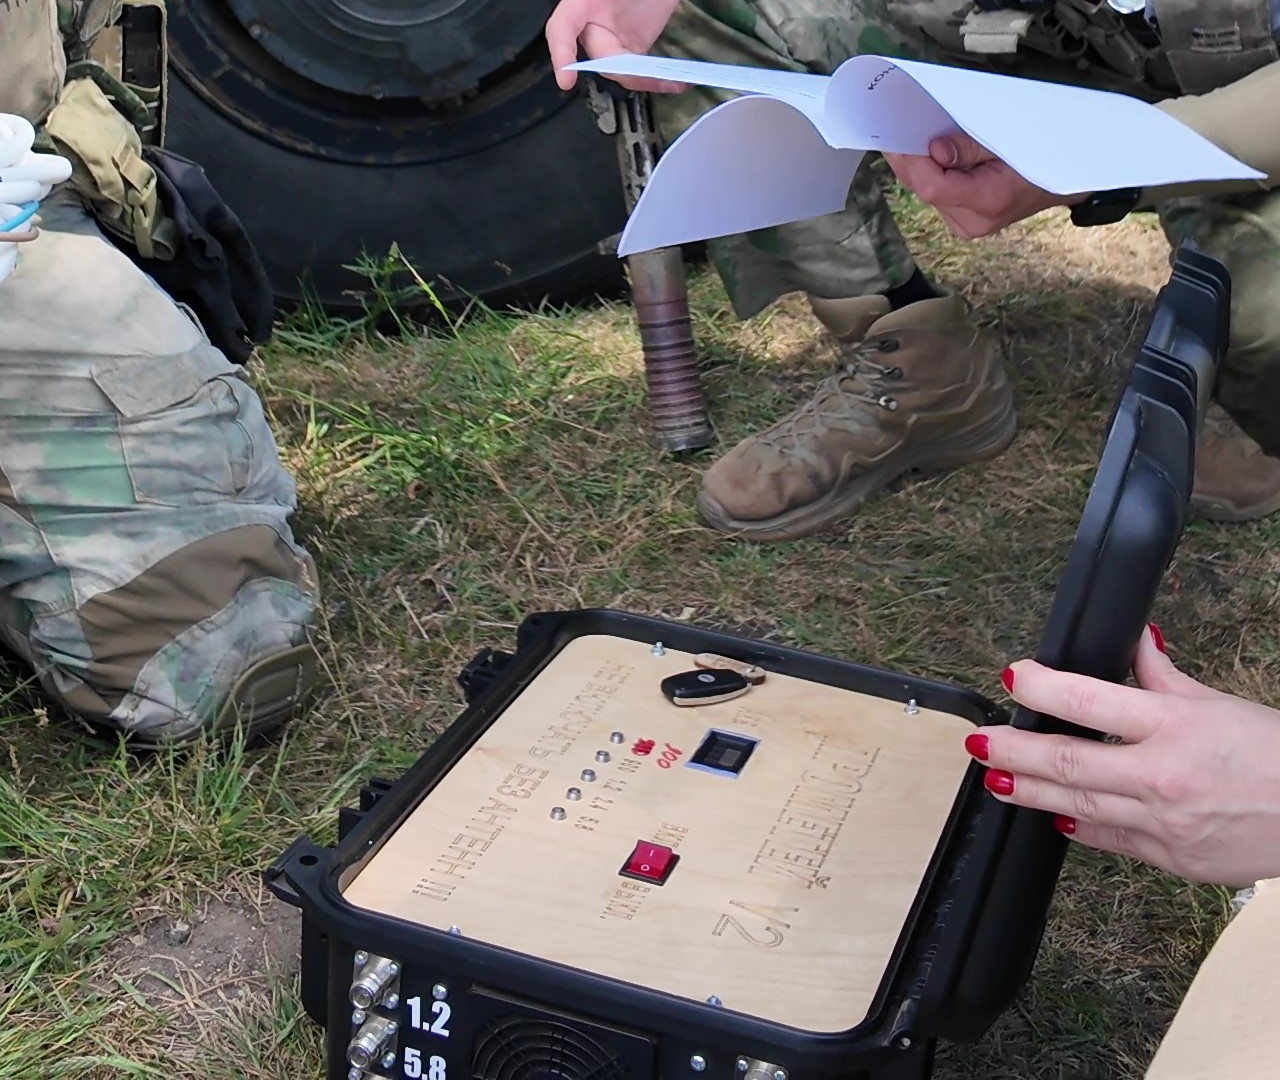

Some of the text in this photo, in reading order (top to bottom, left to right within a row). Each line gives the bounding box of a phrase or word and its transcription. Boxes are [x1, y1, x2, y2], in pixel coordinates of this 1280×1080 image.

[496, 763, 550, 800] БЕЗ
[429, 797, 519, 880] АНТЕНН
[711, 734, 882, 949] ПРОМЕТЕЙ V2
[406, 995, 452, 1038] 1.2
[403, 1046, 448, 1080] 5.8
